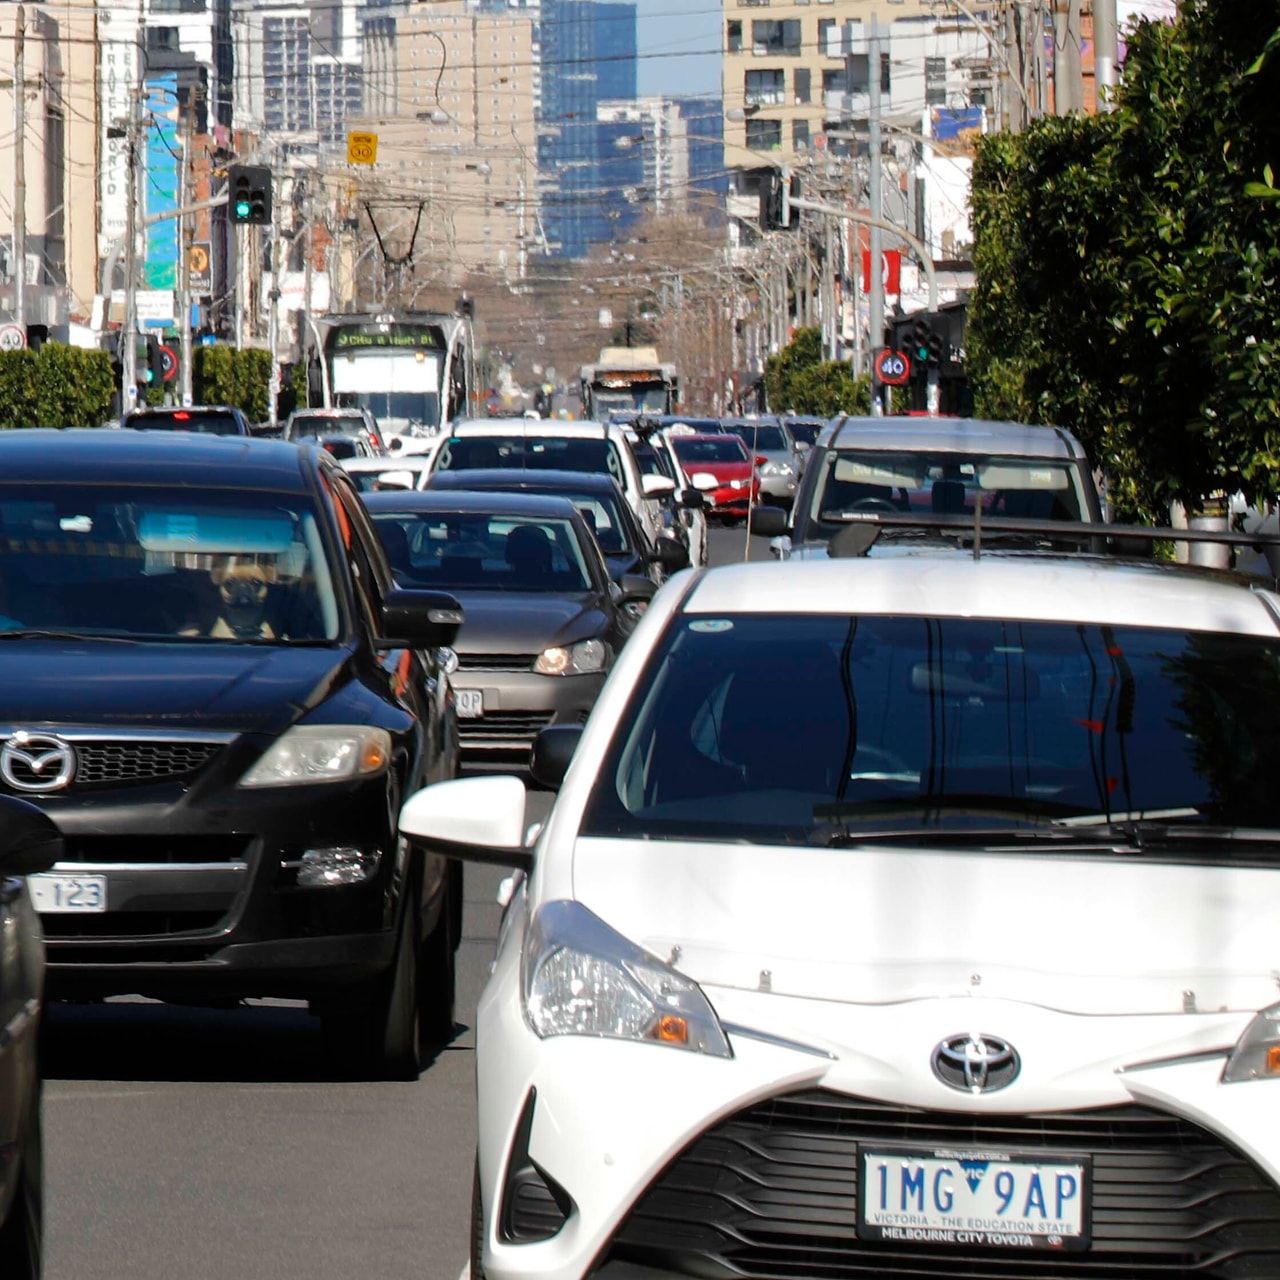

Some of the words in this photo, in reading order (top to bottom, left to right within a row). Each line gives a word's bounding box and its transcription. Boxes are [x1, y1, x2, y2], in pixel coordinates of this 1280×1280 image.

[2, 333, 21, 345] 40
[964, 1170, 986, 1180] VIC
[876, 1161, 954, 1214] 1MG
[993, 1169, 1078, 1220] 9AP
[874, 1213, 929, 1226] VICTORIA
[940, 1217, 964, 1228] THE
[967, 1218, 1034, 1232] EDUCATION
[1039, 1223, 1073, 1234] STATE
[881, 1227, 954, 1243] MELBOURNE
[956, 1232, 985, 1245] CITY
[987, 1233, 1034, 1247] TOYOTA
